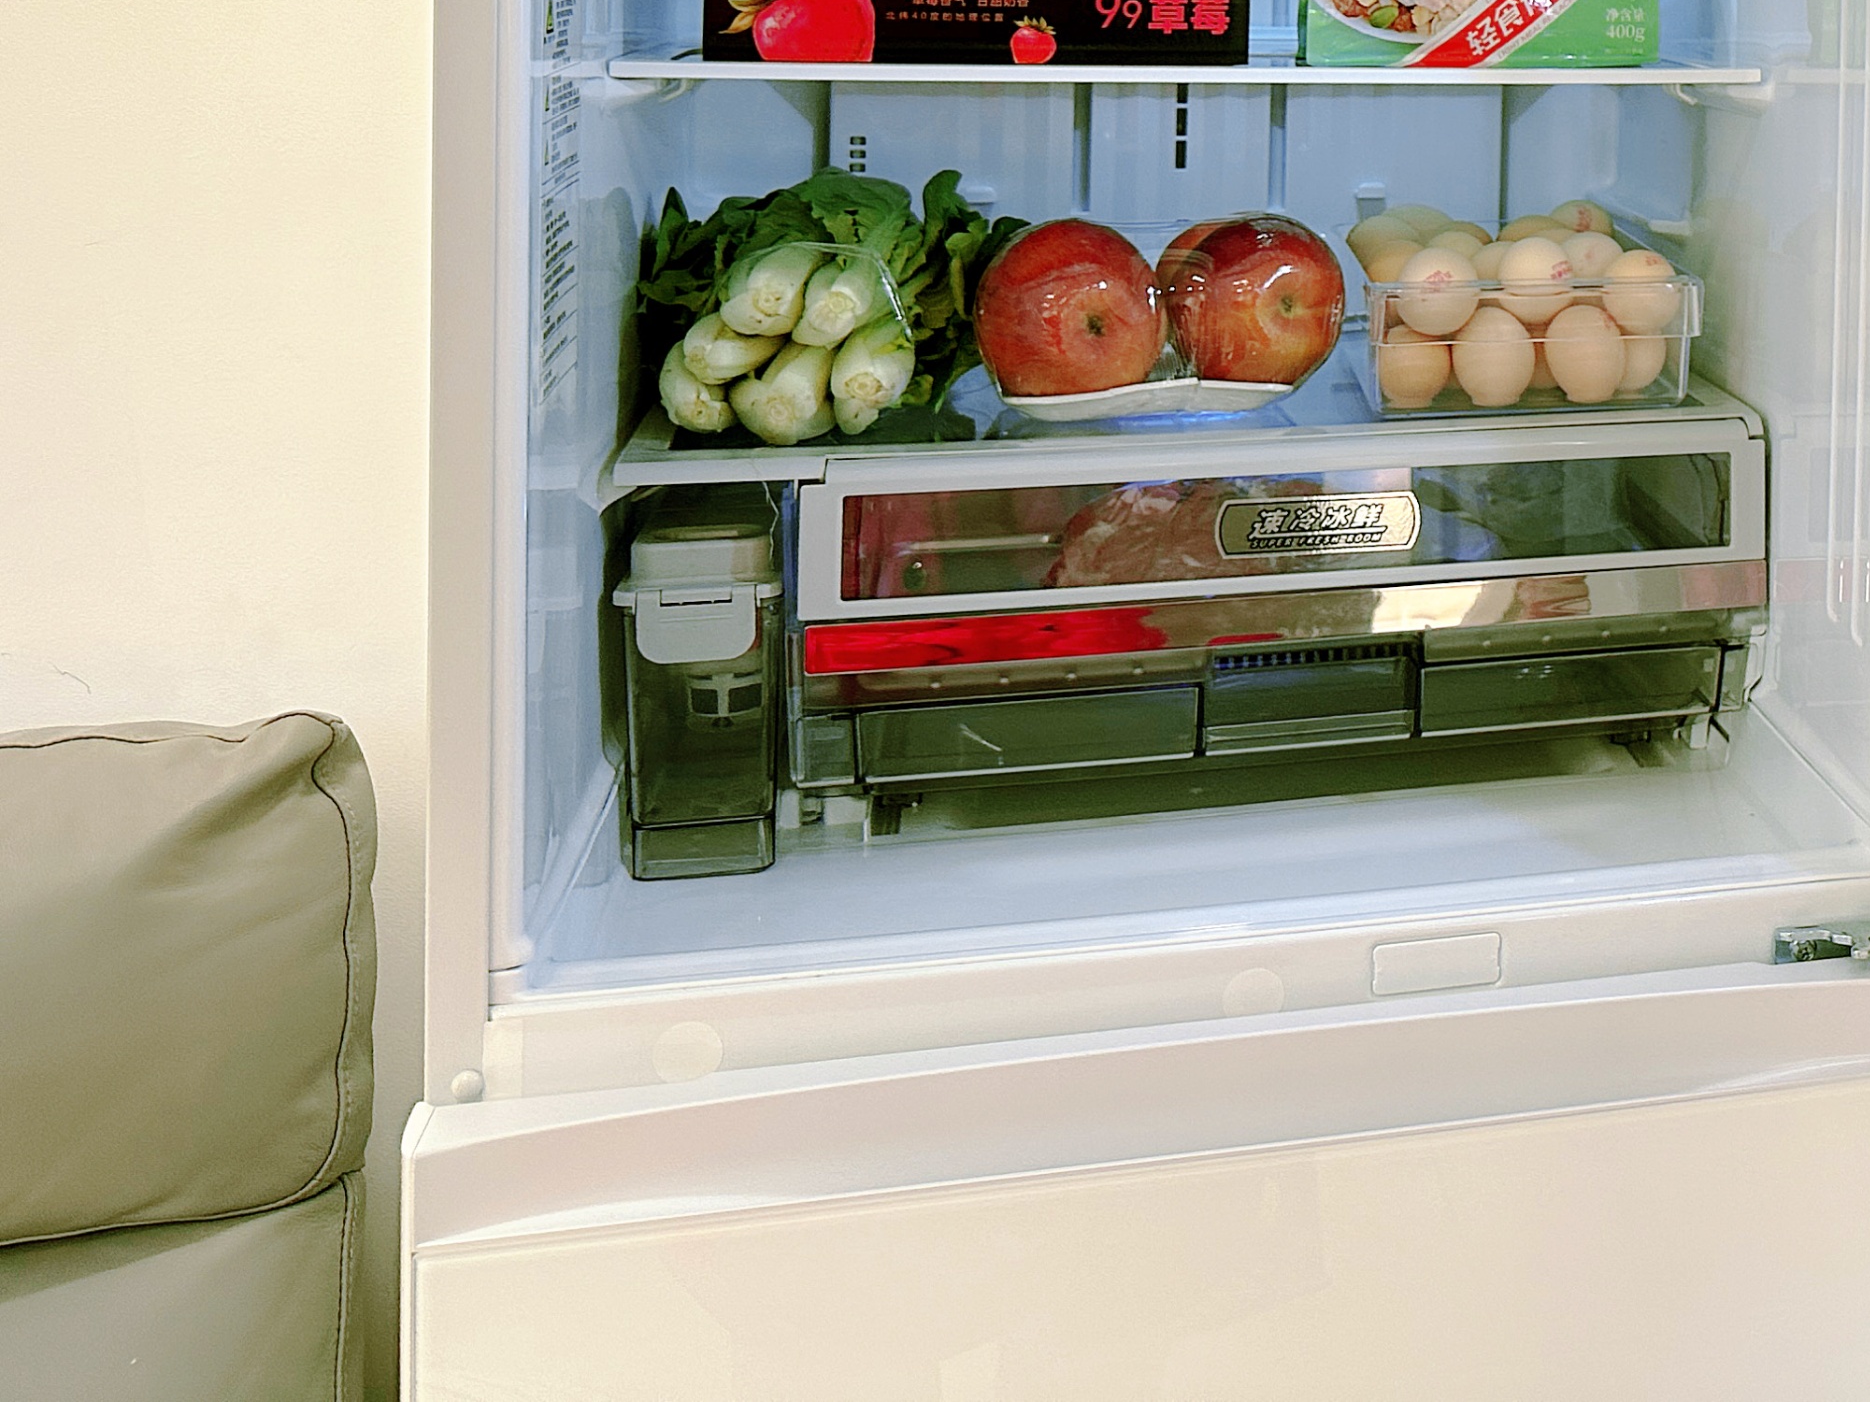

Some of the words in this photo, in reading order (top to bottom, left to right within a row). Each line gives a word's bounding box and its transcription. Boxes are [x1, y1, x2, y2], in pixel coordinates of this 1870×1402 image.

[1606, 23, 1646, 42] 400g
[1251, 537, 1292, 549] SUPER
[1299, 535, 1340, 546] FRESH
[1344, 532, 1382, 544] ROOM
